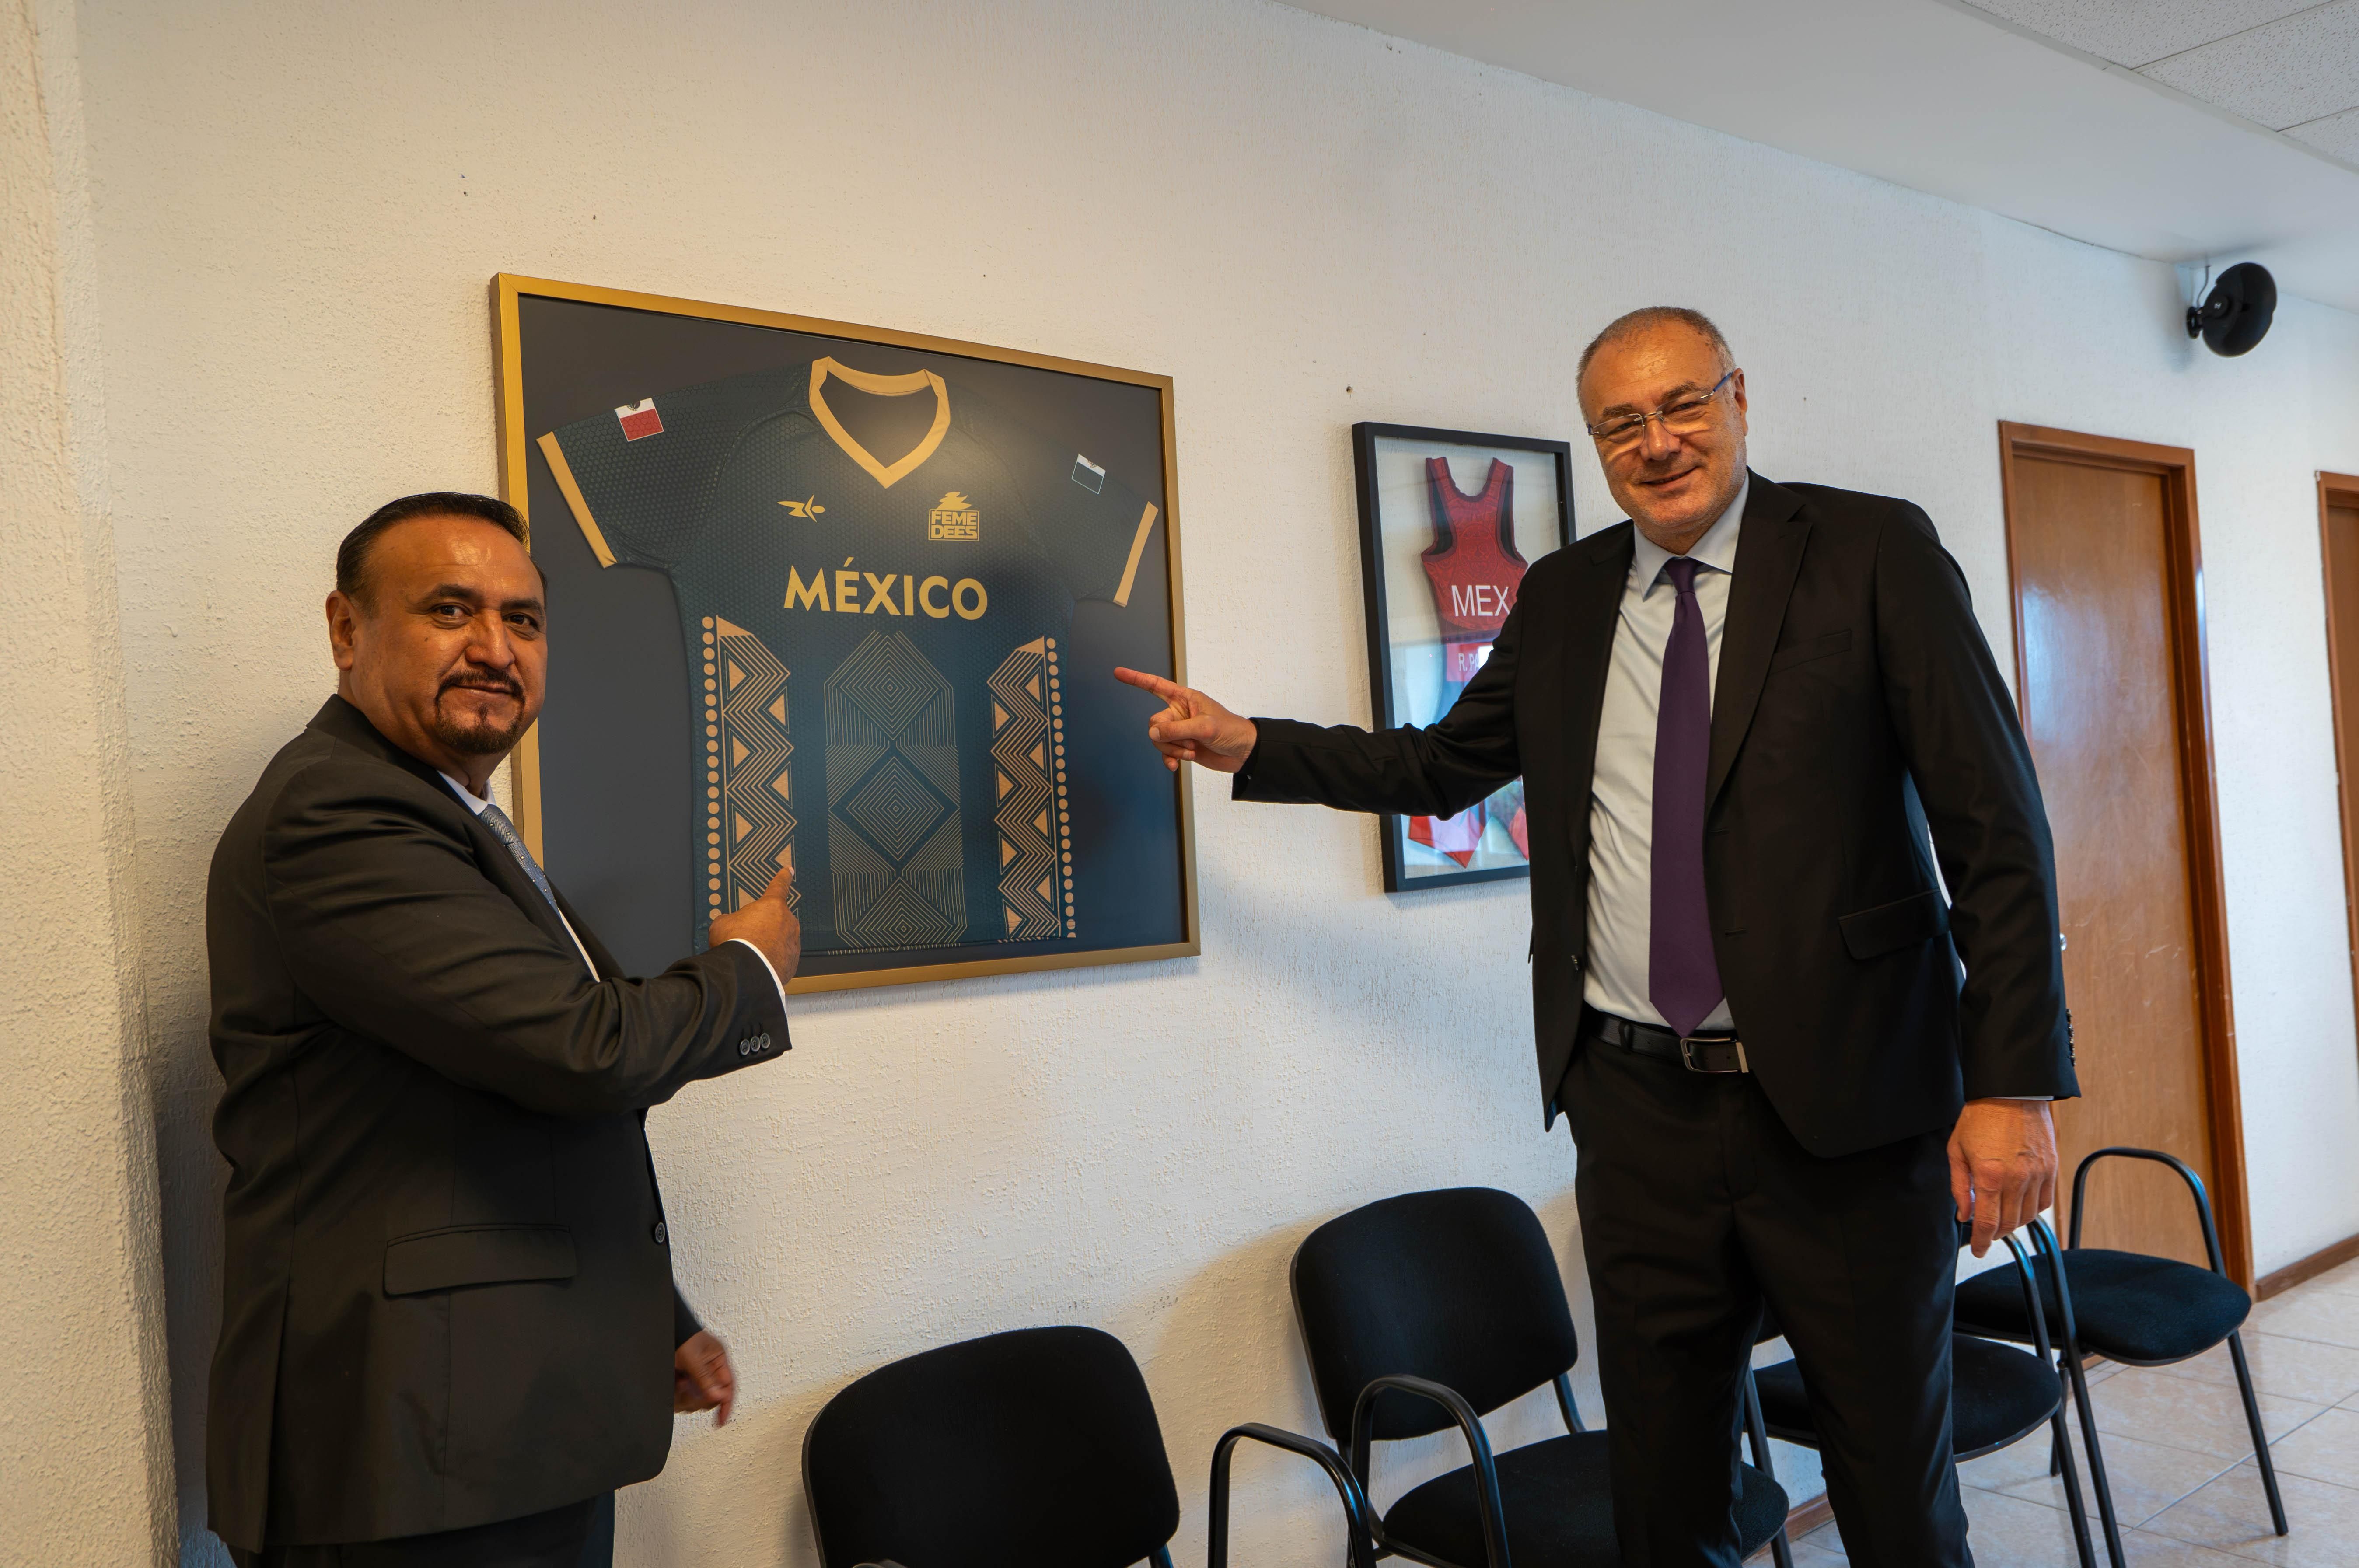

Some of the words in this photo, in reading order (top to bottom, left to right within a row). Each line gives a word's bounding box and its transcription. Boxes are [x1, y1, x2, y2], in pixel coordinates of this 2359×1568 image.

[931, 510, 977, 525] FEME
[930, 524, 978, 539] DEES
[783, 557, 988, 620] MÉXICO
[1451, 585, 1510, 617] MEX
